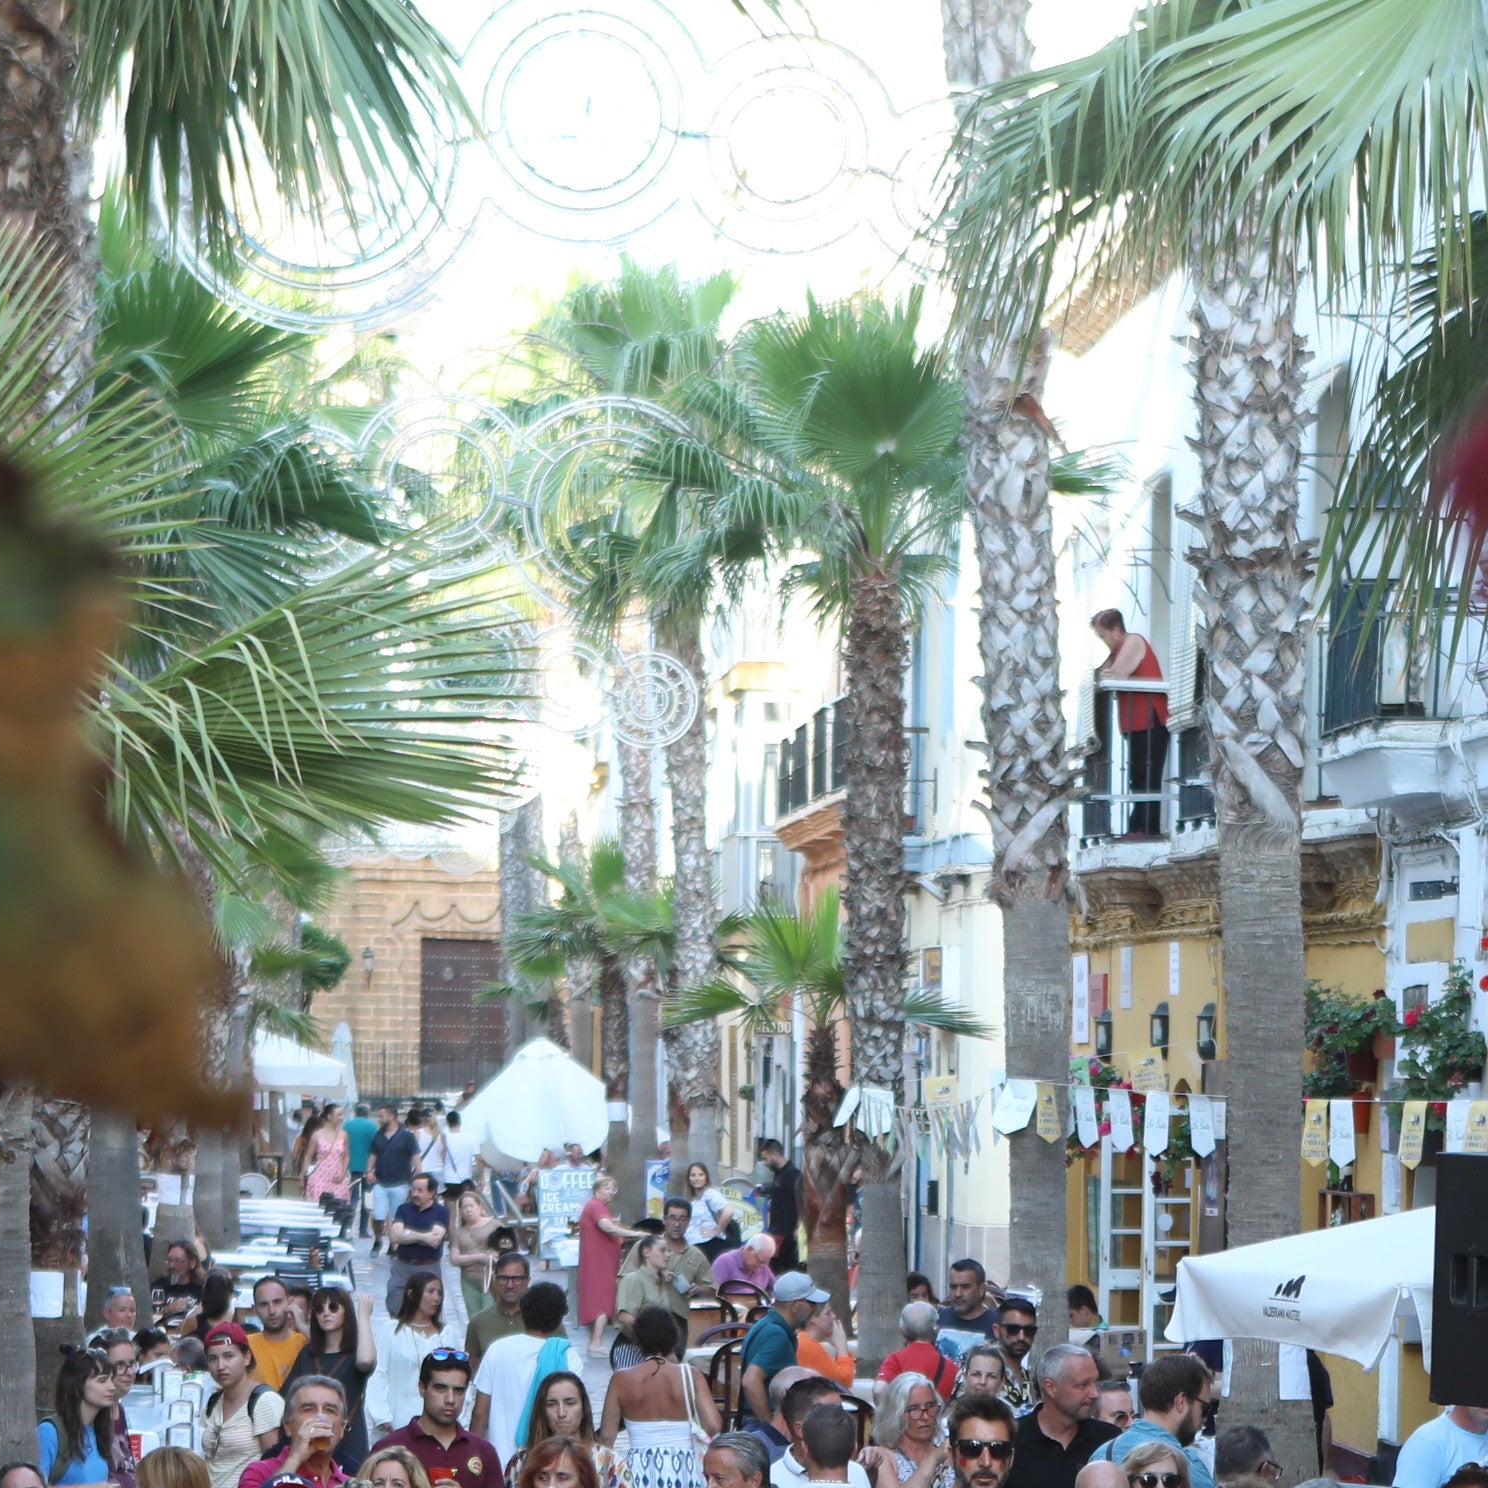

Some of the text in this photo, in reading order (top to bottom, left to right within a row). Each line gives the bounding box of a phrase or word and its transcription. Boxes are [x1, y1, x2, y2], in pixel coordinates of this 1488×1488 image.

[542, 1191, 560, 1203] ICE
[540, 1202, 580, 1214] CREAM
[272, 1474, 304, 1487] FILA
